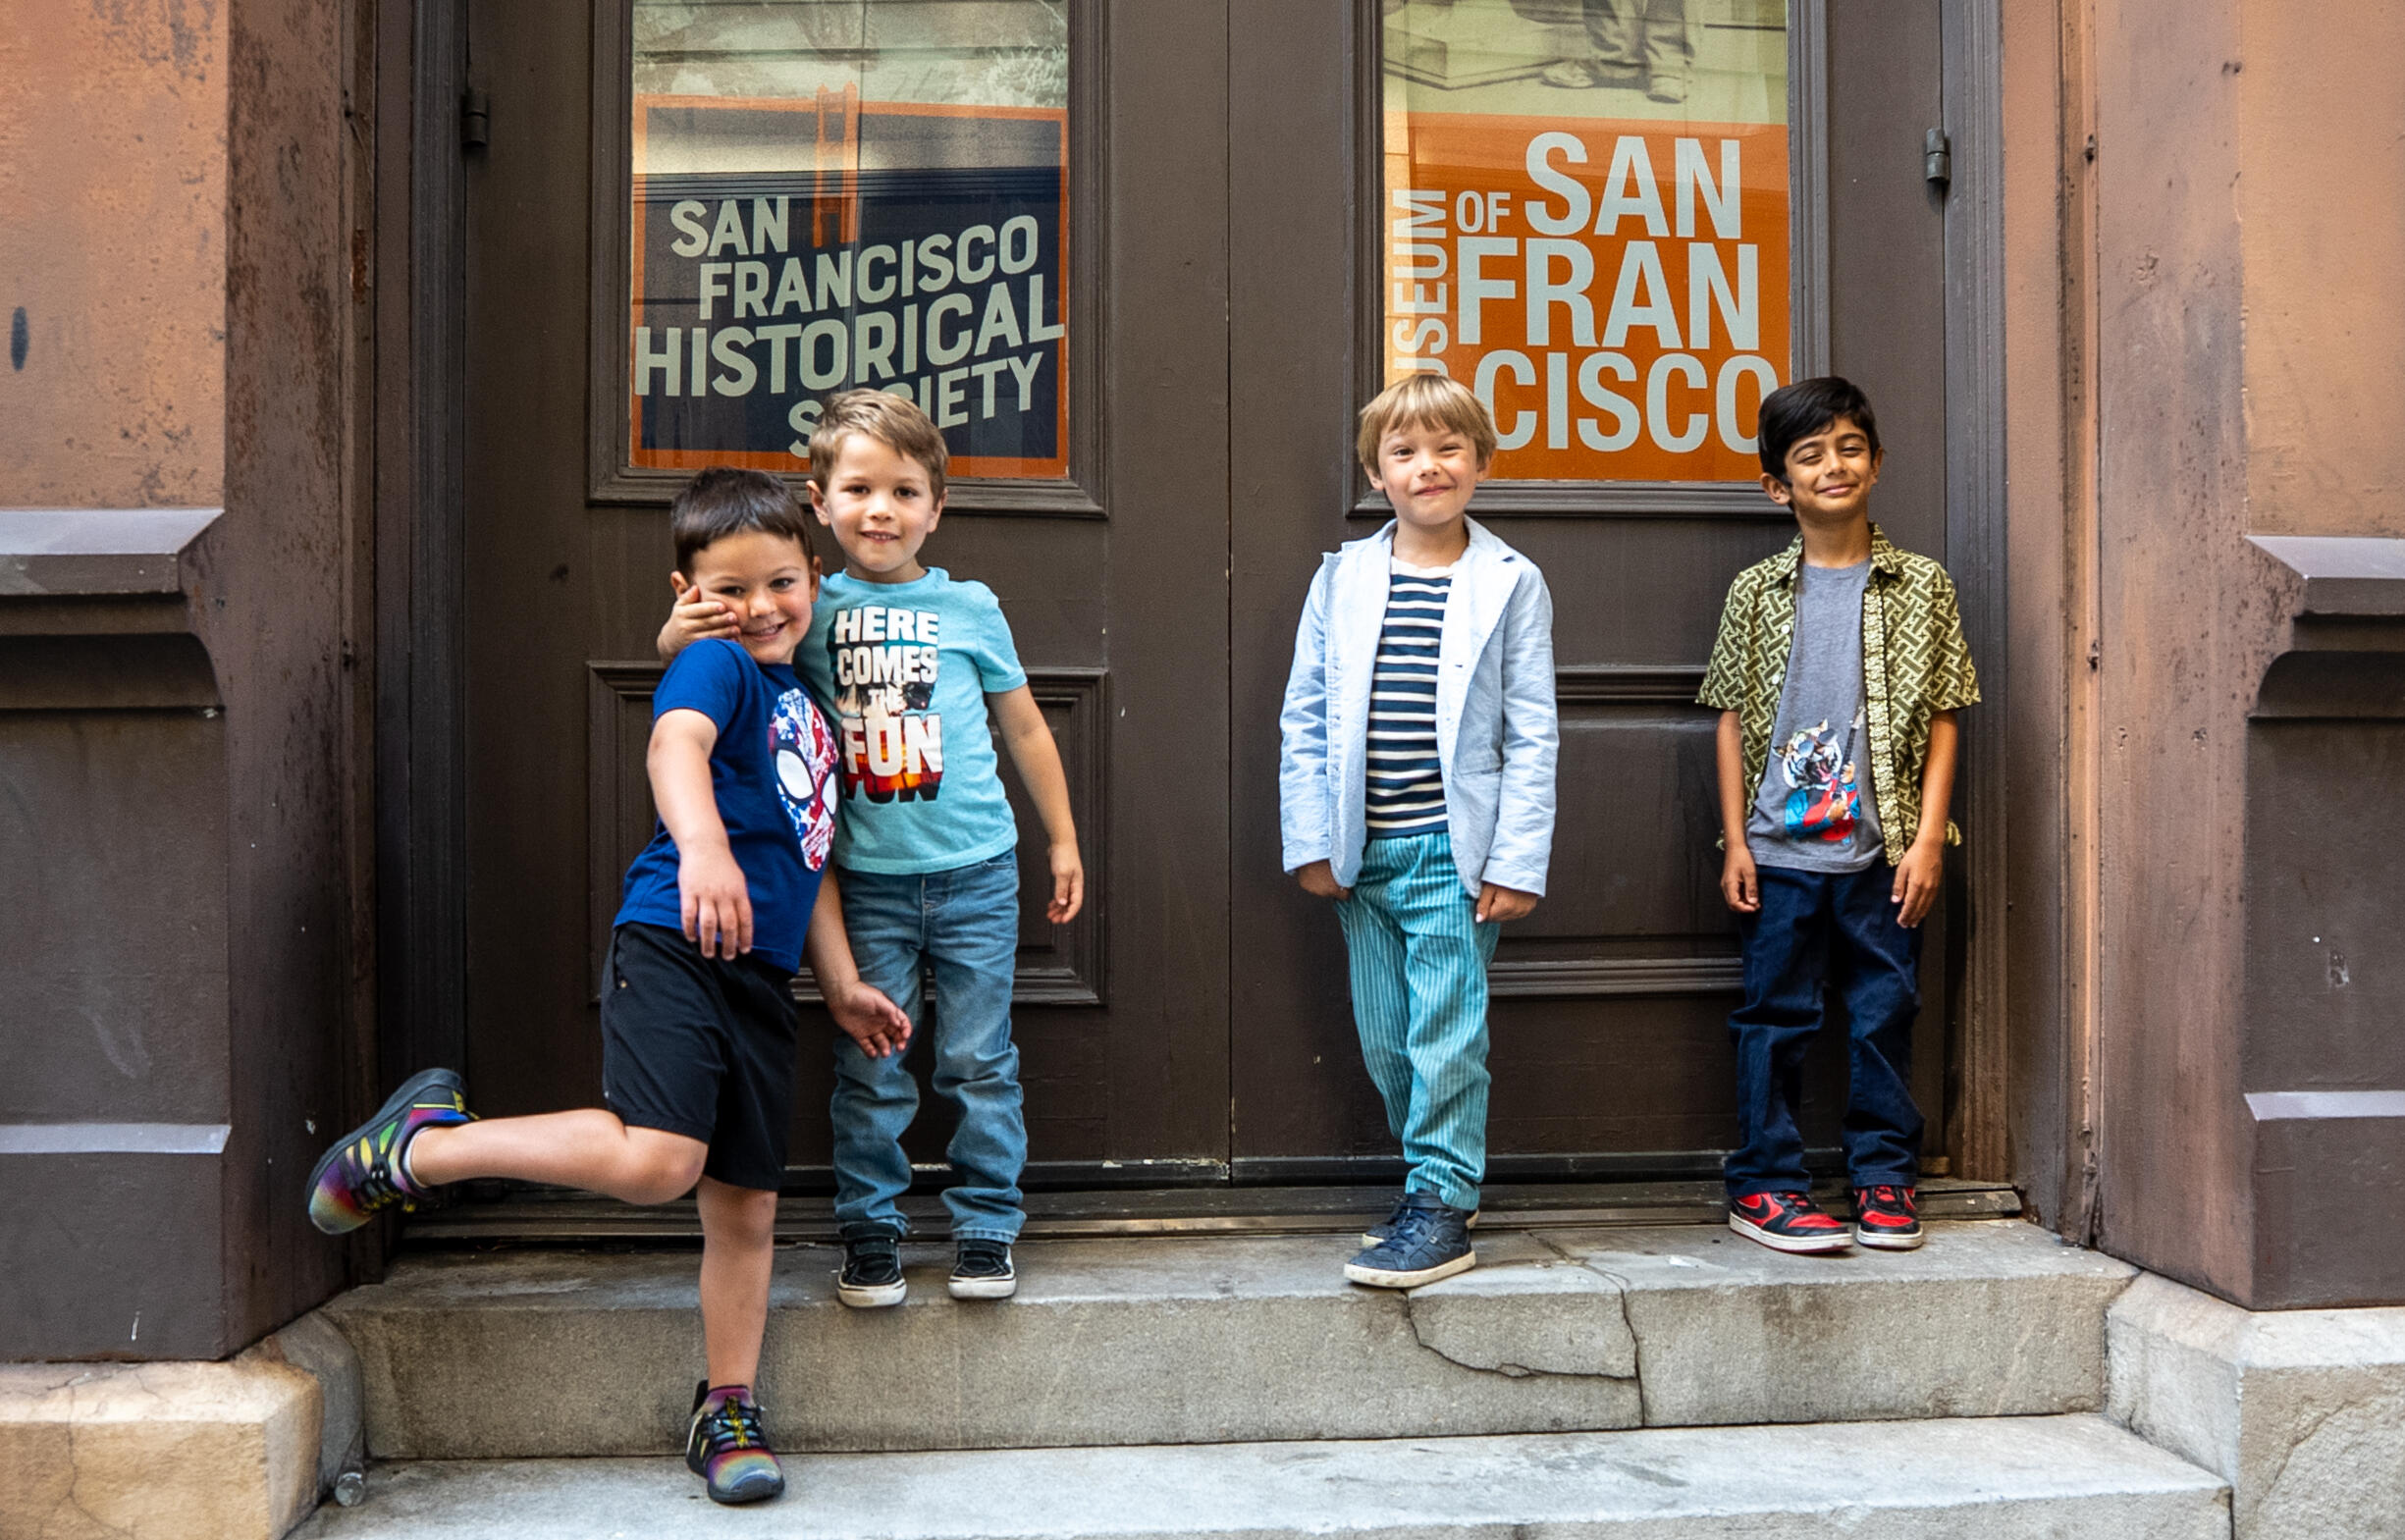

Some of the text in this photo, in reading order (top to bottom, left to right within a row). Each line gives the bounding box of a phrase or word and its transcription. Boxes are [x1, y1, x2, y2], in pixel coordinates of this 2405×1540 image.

[669, 196, 788, 258] SAN
[1455, 190, 1511, 234] OF
[1524, 132, 1741, 239] SAN
[699, 215, 1039, 321] FRANCISCO
[1393, 188, 1448, 378] USEUM
[1456, 237, 1760, 351] FRAN
[634, 274, 1066, 398] HISTORICAL
[788, 352, 1043, 458] SIETY
[1473, 349, 1779, 454] CISCO
[834, 606, 938, 645] HERE
[837, 645, 938, 686] COMES
[841, 715, 943, 777] FUN
